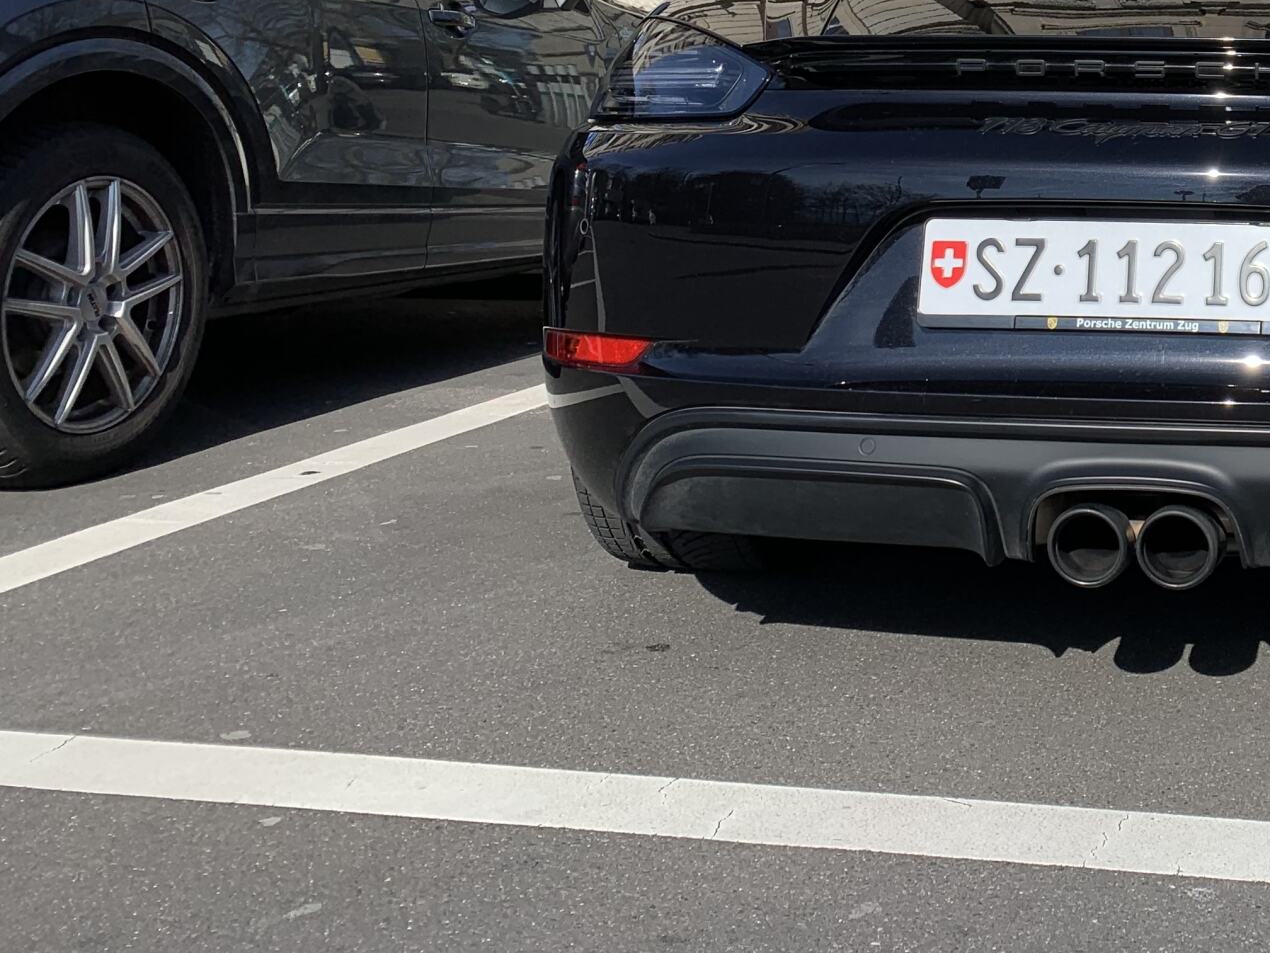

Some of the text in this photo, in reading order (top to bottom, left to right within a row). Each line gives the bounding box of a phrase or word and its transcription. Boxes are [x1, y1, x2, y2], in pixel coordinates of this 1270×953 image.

[978, 117, 1048, 135] 718
[1049, 118, 1201, 145] Cayman
[1076, 318, 1200, 332] Porsche Zentrum Zug
